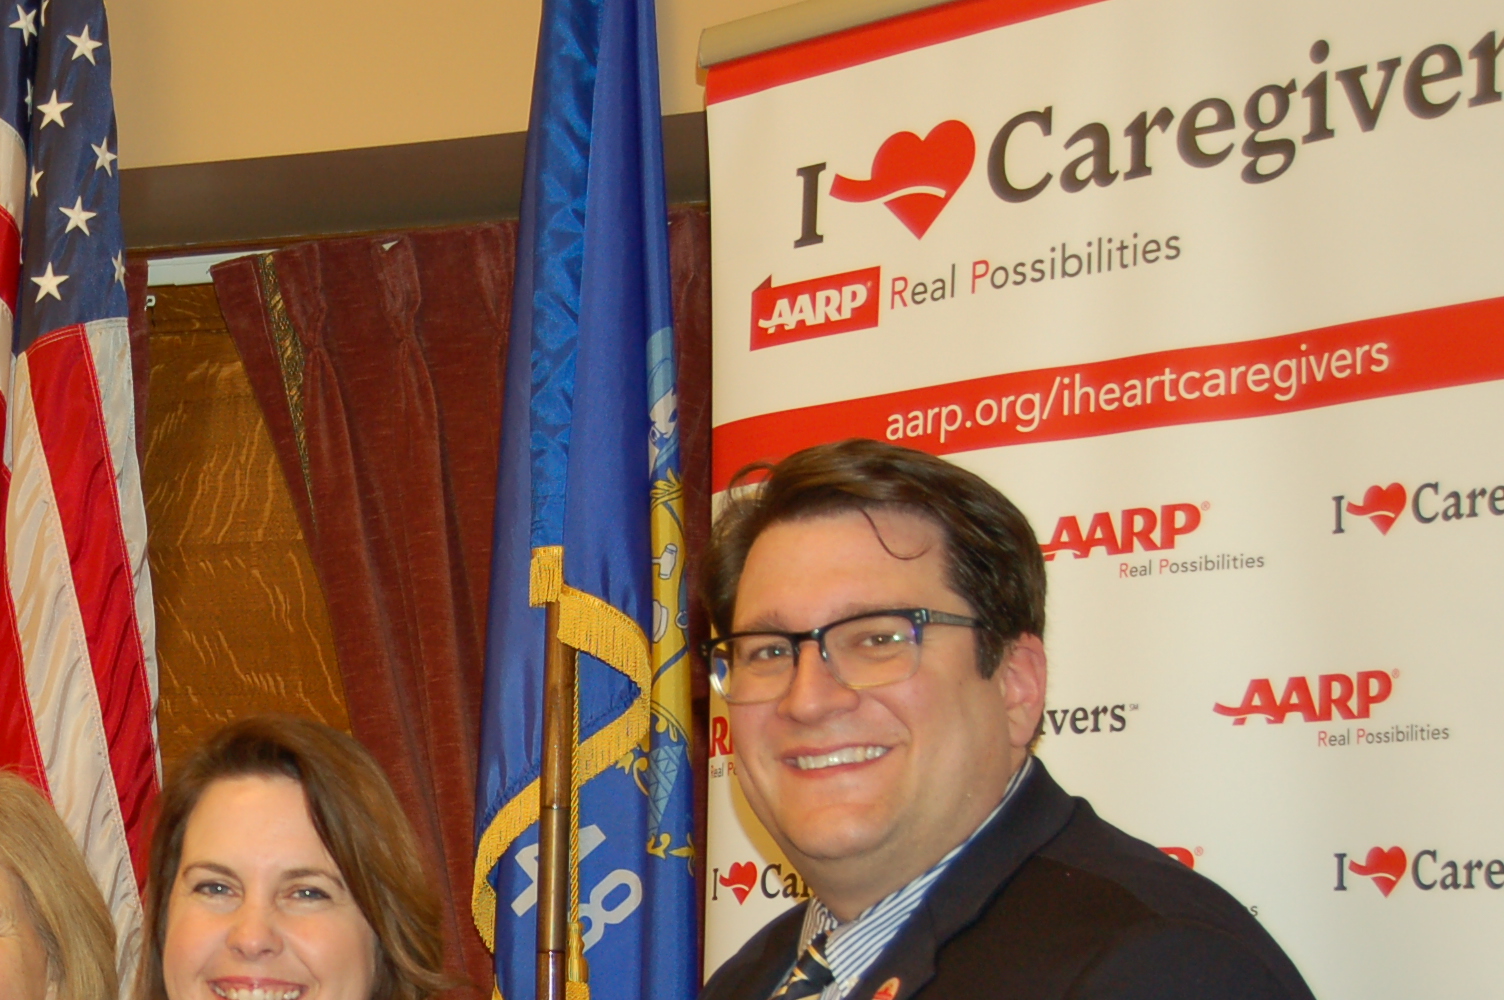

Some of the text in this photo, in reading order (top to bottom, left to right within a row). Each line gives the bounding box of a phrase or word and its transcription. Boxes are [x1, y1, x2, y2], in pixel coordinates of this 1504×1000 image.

[793, 162, 826, 249] I
[890, 263, 956, 309] Real
[970, 231, 1183, 295] Possibilities
[885, 338, 1391, 445] aarp.org/iheartcaregivers
[1118, 553, 1265, 579] Real Possibilities
[1317, 724, 1450, 748] Real Possibilities
